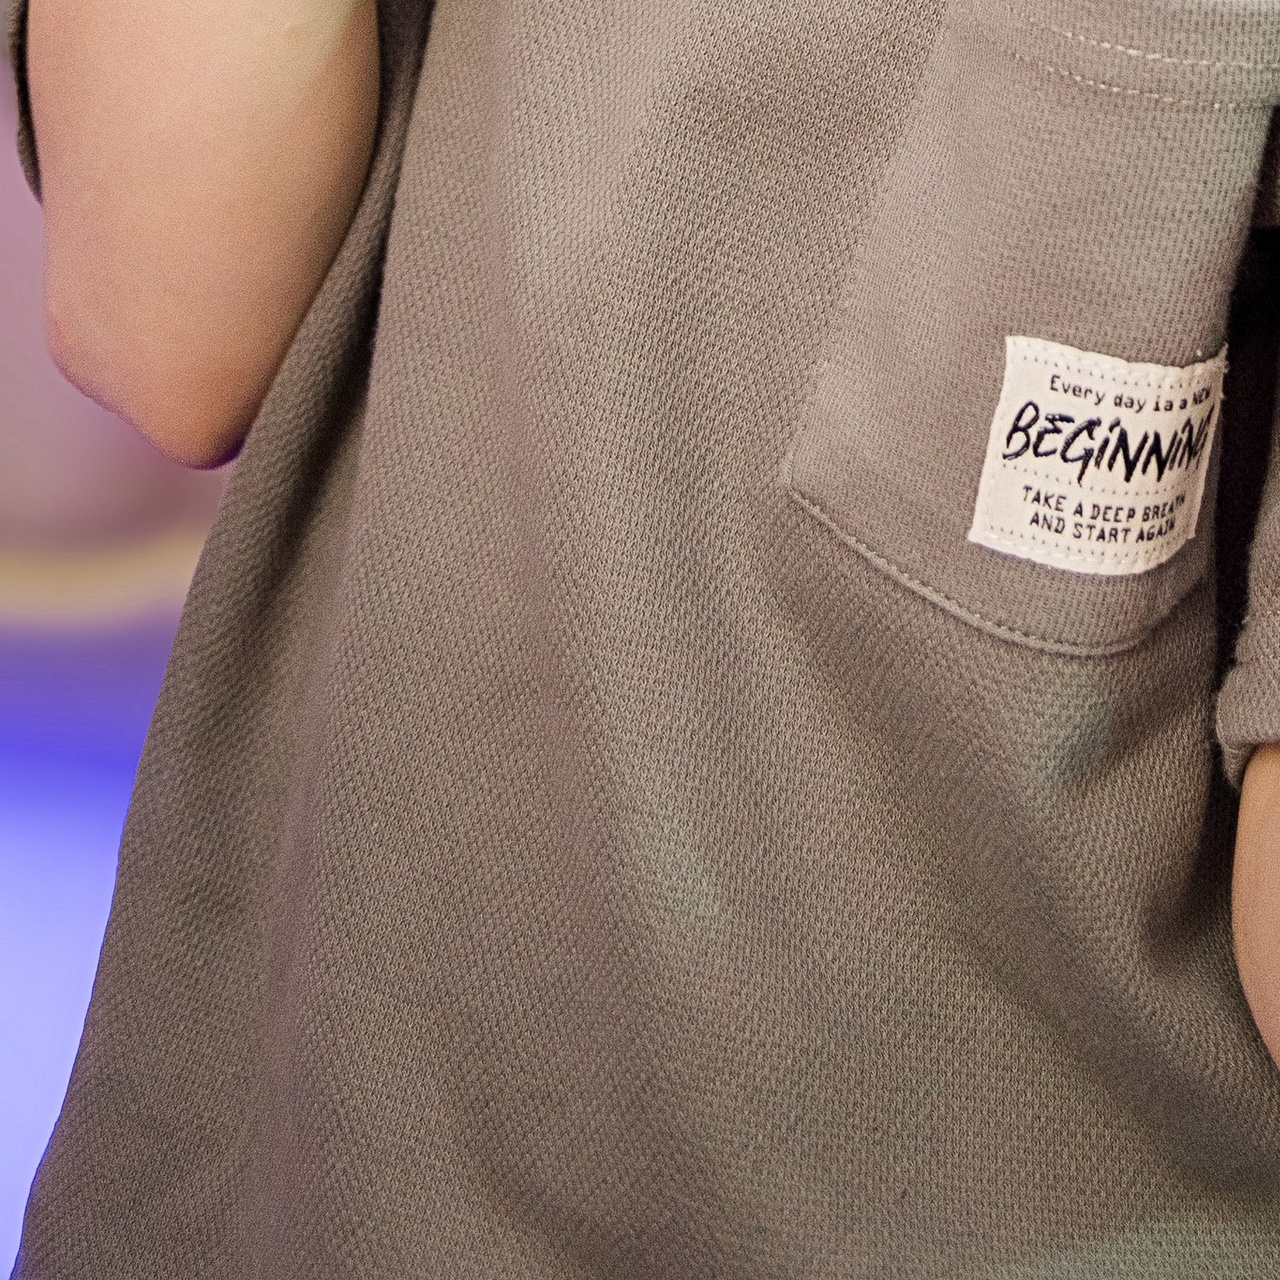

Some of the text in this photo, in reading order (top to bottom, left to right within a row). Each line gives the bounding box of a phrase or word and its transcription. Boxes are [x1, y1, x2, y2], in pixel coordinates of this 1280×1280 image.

[1049, 374, 1106, 406] Every
[1113, 392, 1147, 414] day
[1178, 397, 1188, 411] a
[1022, 484, 1186, 523] TAKE A DEEP BREATH
[1029, 510, 1176, 544] AND START AGAIN
